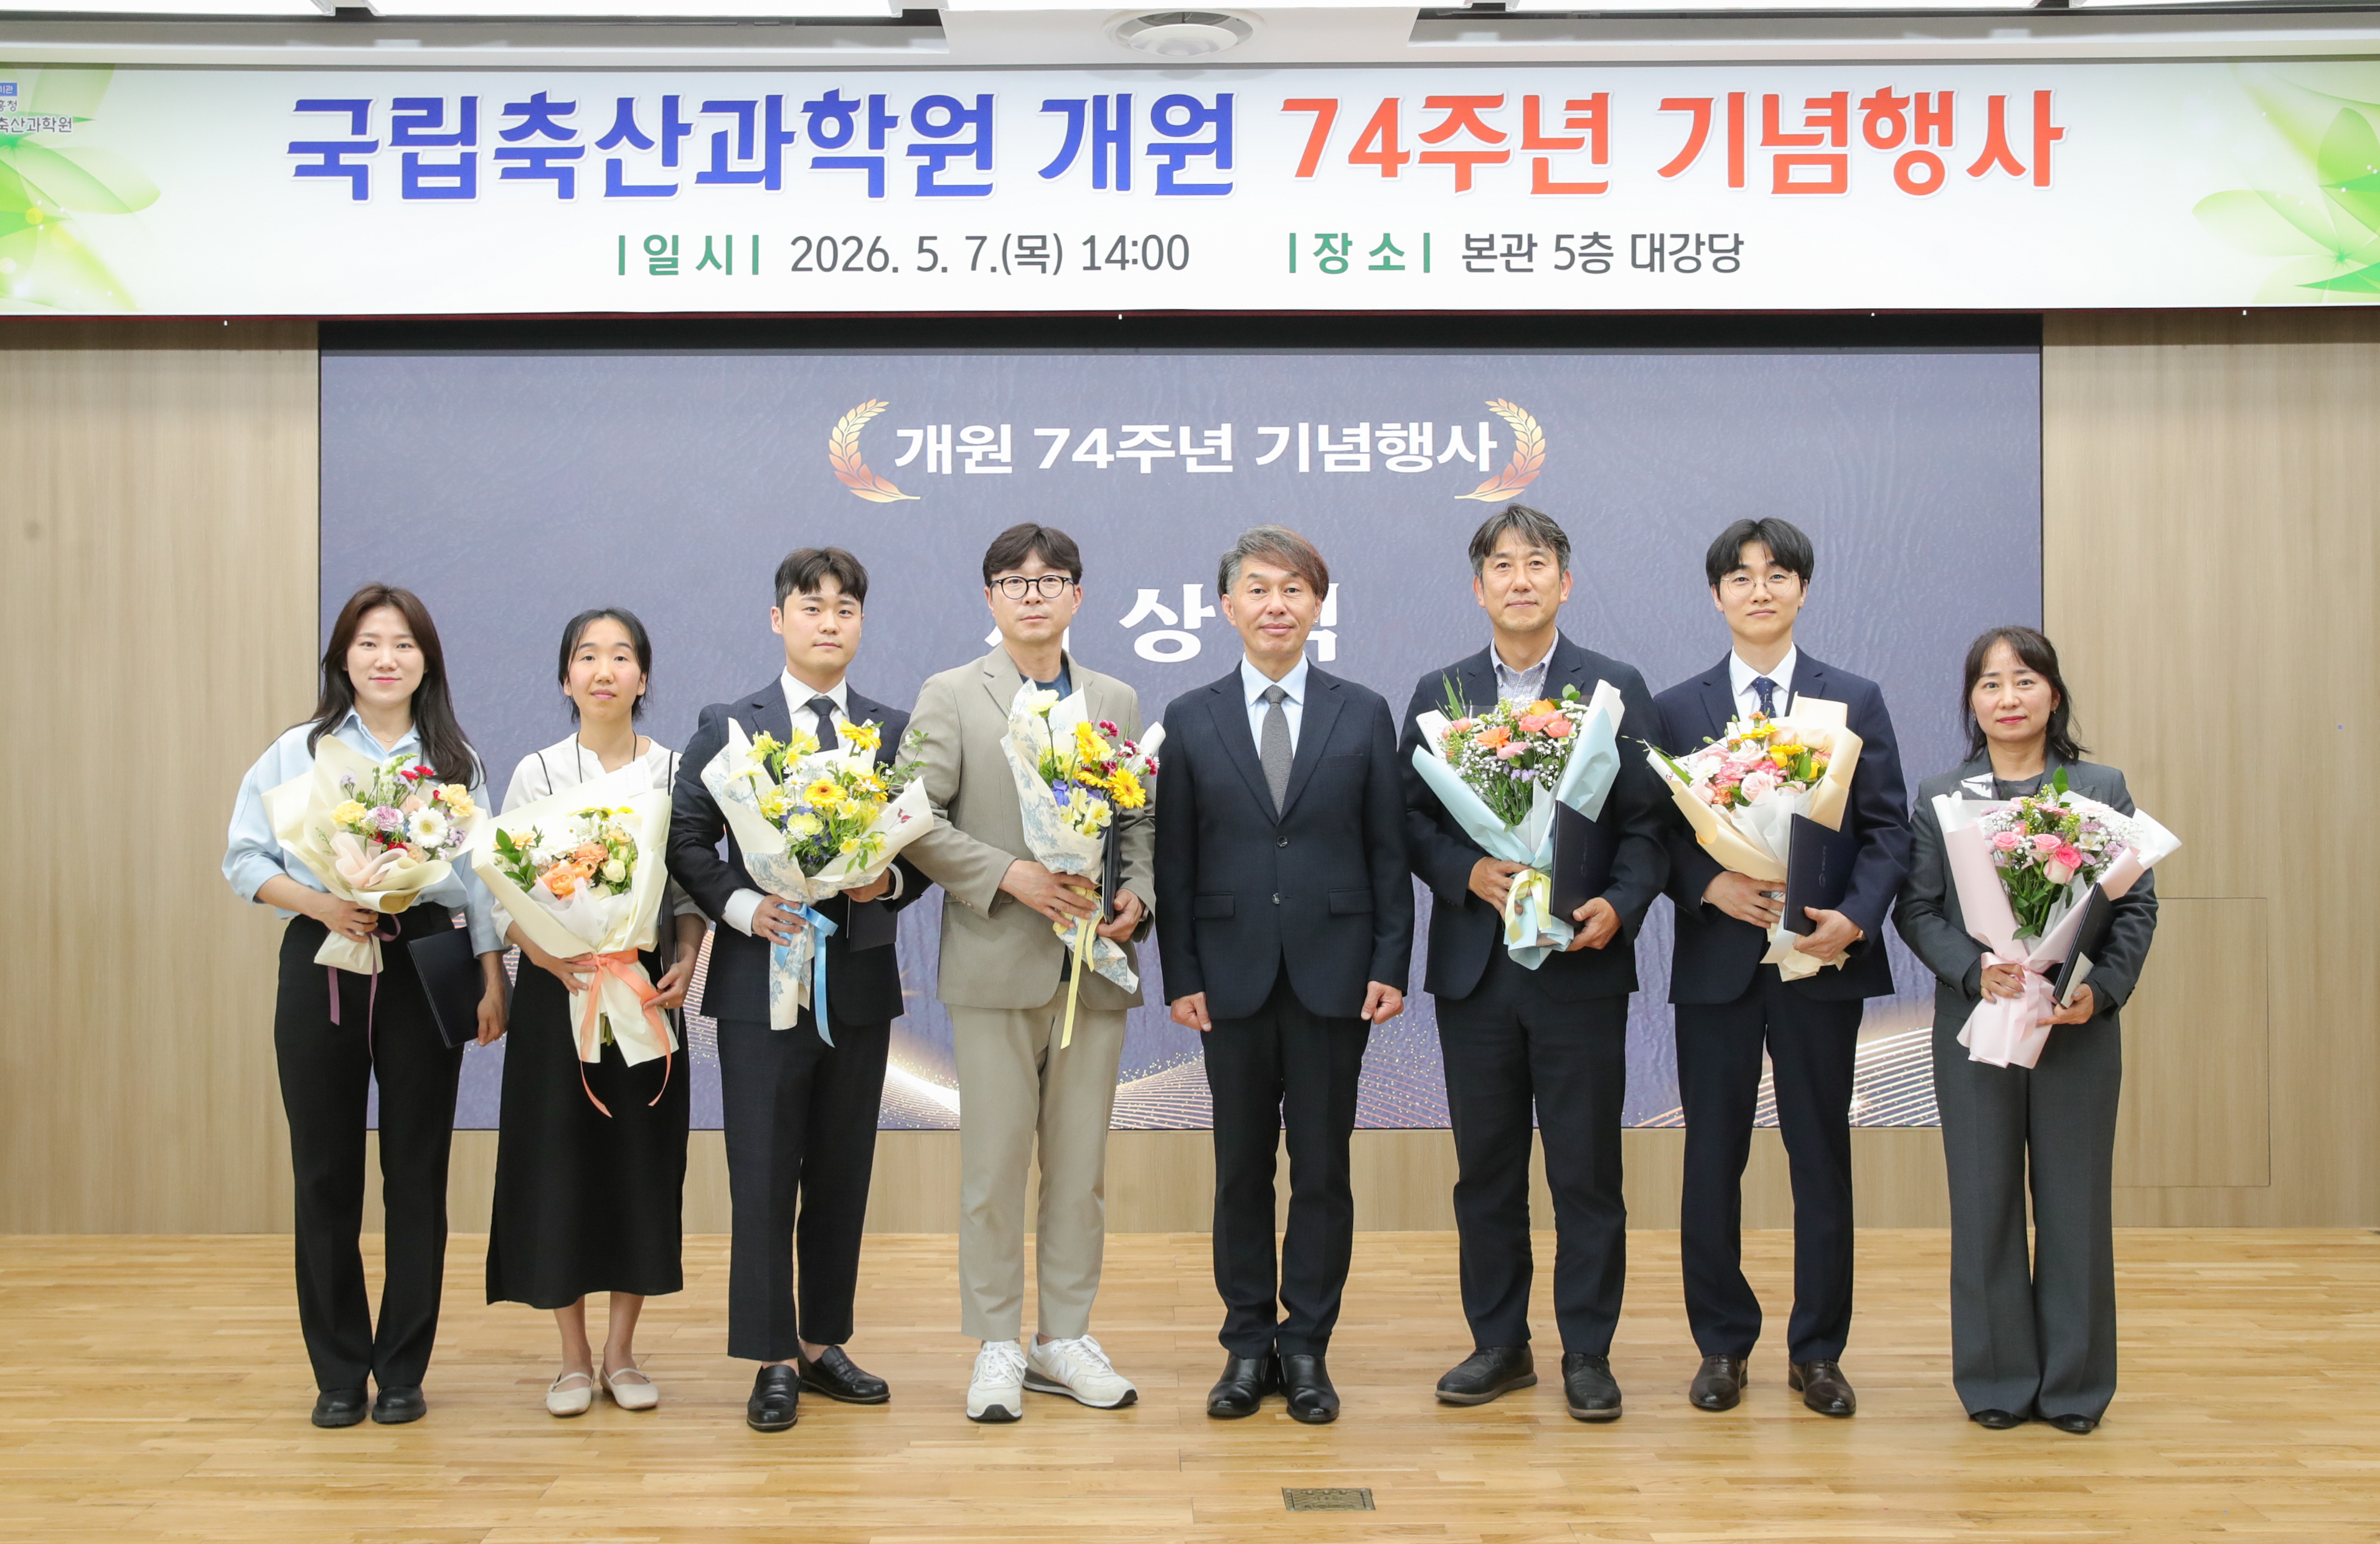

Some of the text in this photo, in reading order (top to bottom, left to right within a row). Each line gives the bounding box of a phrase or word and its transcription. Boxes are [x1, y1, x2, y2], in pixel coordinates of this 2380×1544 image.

[288, 86, 2066, 202] 국립축산과학원 개원 74주년 기념행사
[791, 235, 900, 275] 2026.
[917, 236, 949, 274] 5.
[965, 233, 1064, 276] 7.(목)
[1082, 234, 1190, 272] 14:00
[1462, 233, 1539, 274] 본관
[1554, 232, 1615, 275] 5층
[1631, 233, 1746, 275] 대강당
[895, 421, 1498, 476] 개원 74주년 기념행사
